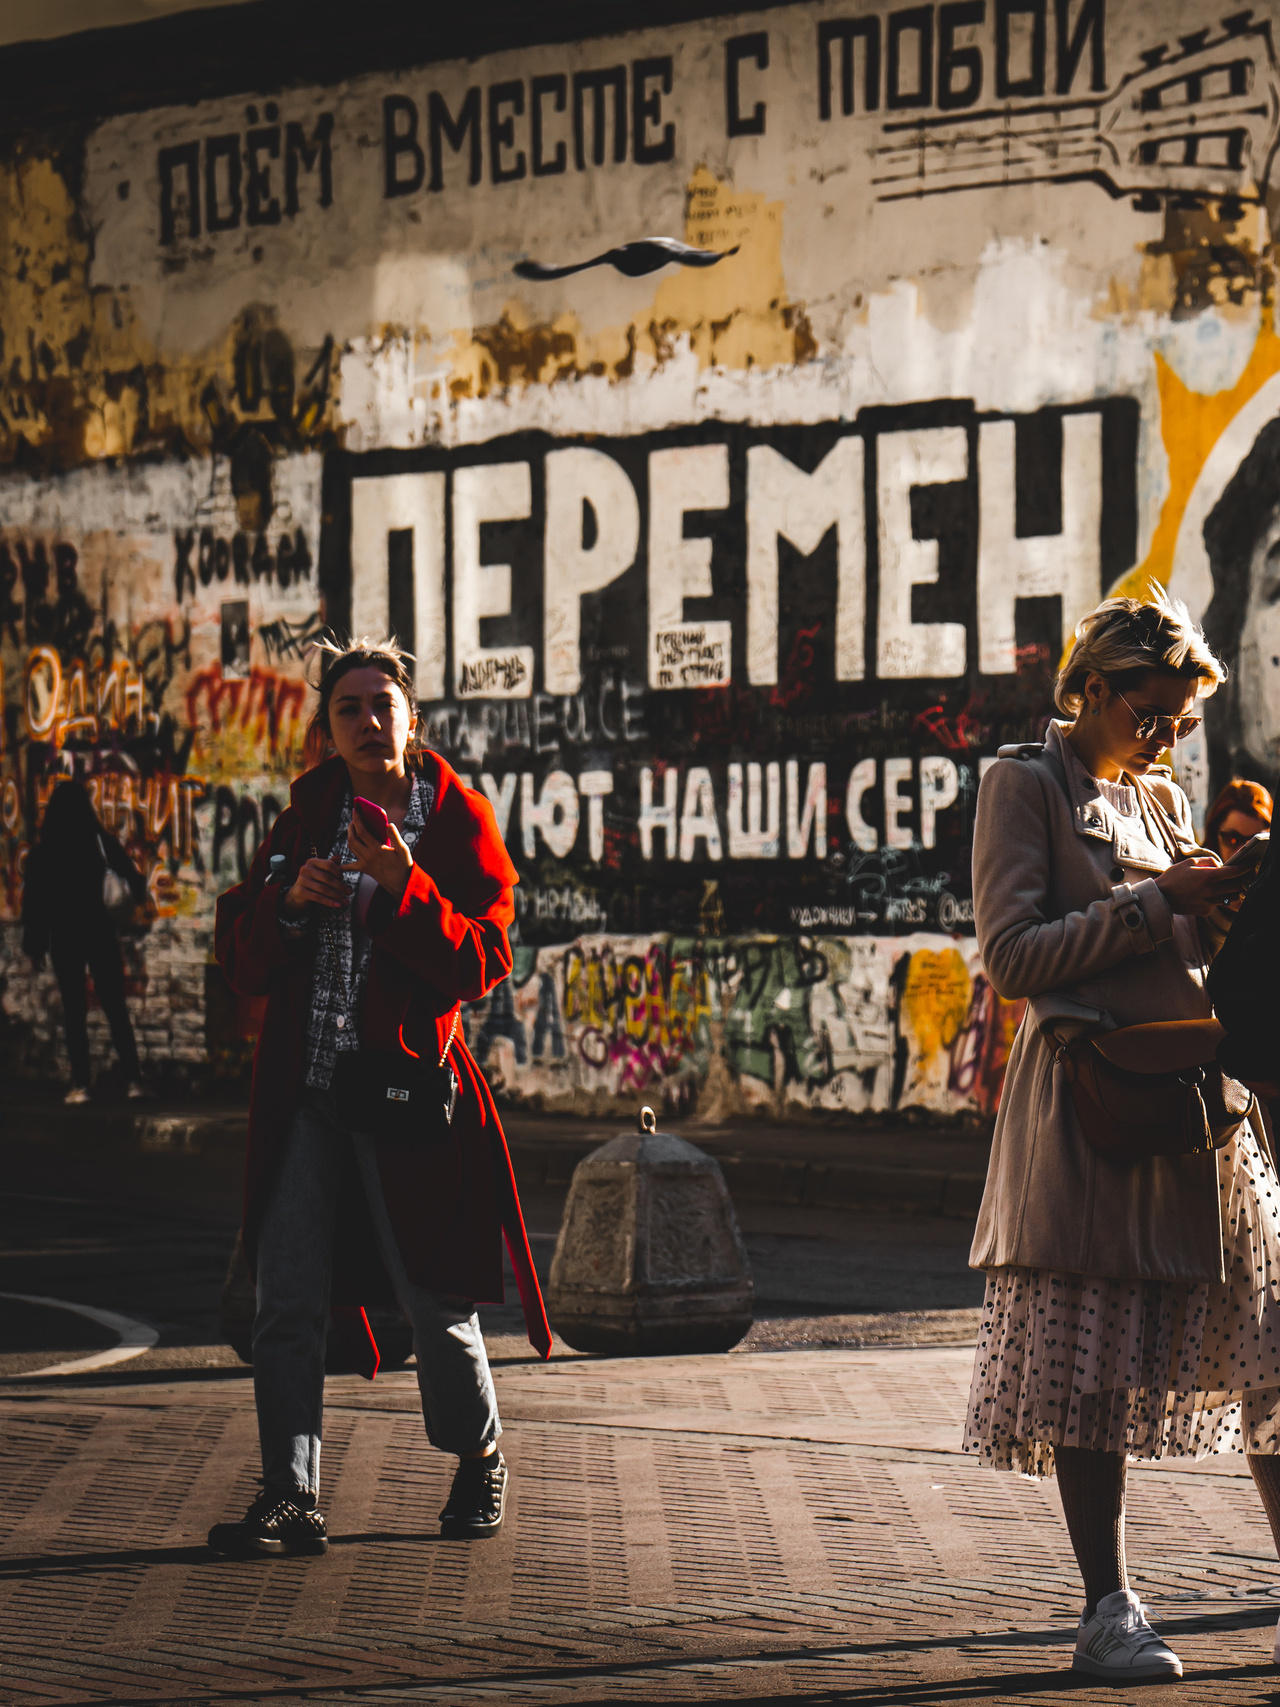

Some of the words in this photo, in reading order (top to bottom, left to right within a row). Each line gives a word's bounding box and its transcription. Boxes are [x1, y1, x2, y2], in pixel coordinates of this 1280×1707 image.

[157, 103, 335, 246] ПОЁМ
[382, 56, 677, 200] ВМЕСТЕ
[725, 31, 770, 138] С
[350, 411, 1103, 701] ПЕРЕМЕН
[462, 767, 615, 862] УЮТ
[637, 758, 829, 861] НАШИ
[845, 755, 1000, 850] СЕР
